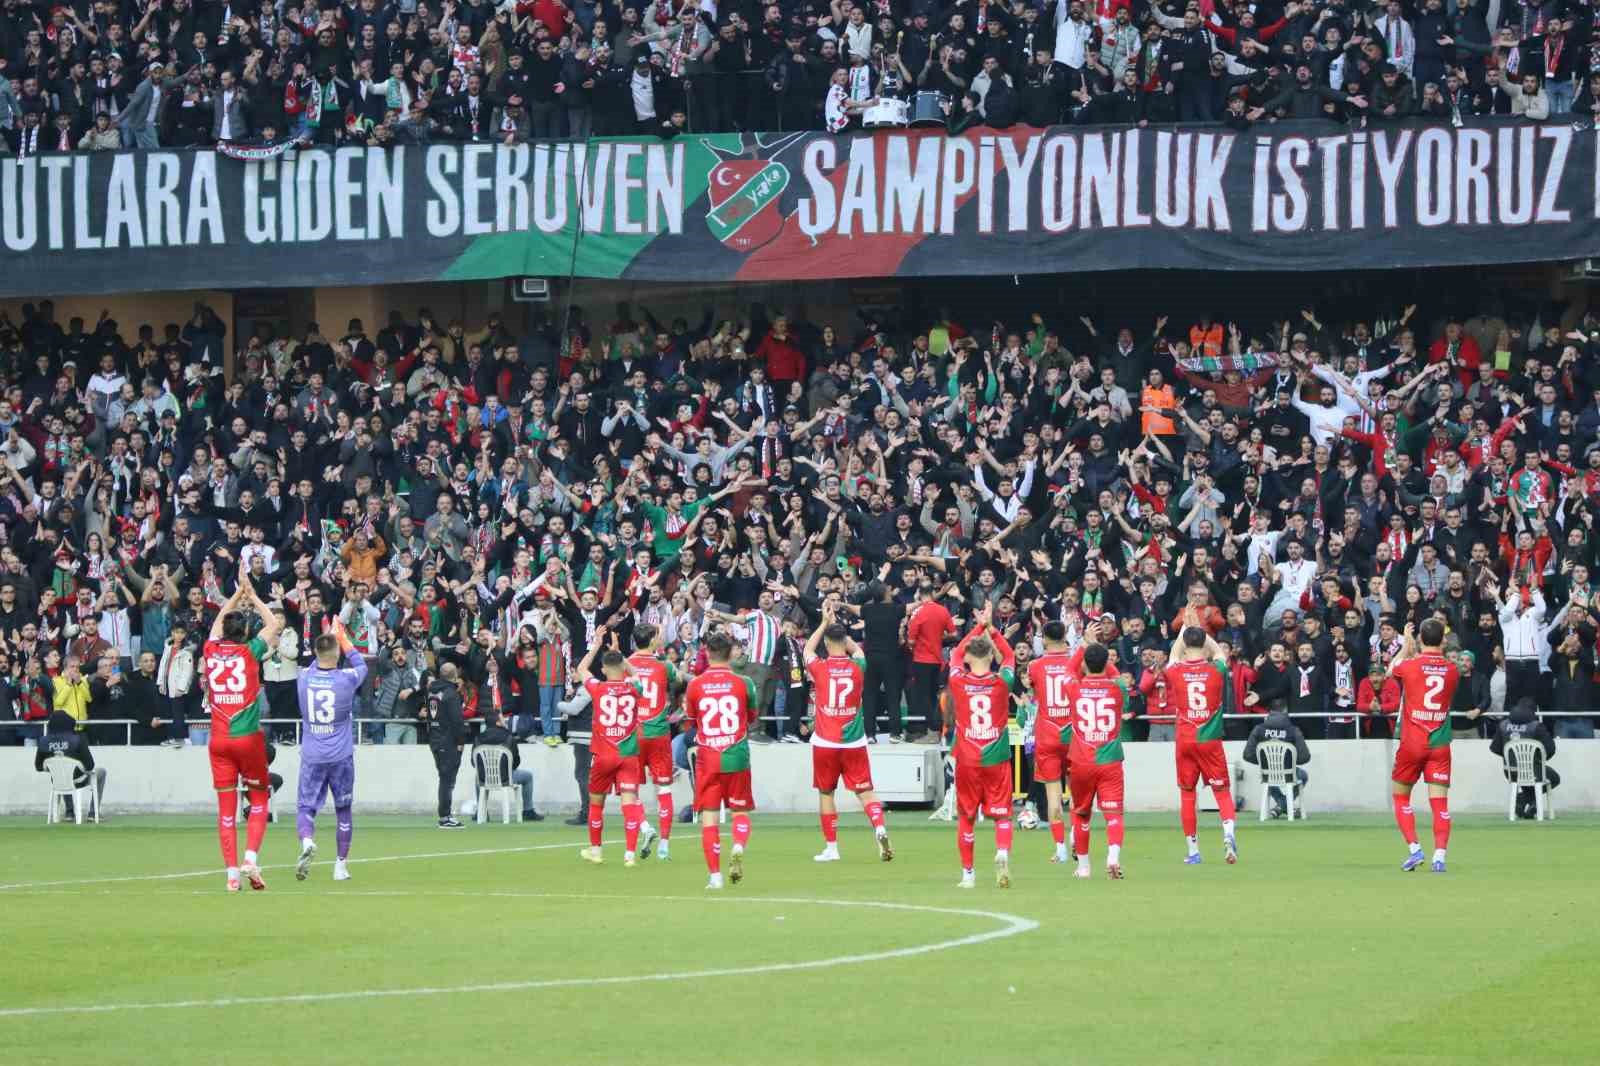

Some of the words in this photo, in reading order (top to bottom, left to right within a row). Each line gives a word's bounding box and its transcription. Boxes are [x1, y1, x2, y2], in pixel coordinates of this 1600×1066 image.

[2, 150, 226, 252] UTLARA
[798, 128, 1235, 246] ŞAMPİYONLUK
[1251, 126, 1574, 233] İSTİYORUZ
[208, 656, 247, 692] 23
[1045, 675, 1070, 707] 10
[307, 688, 336, 724] 13
[642, 677, 658, 708] 4
[828, 677, 854, 708] 17
[1187, 681, 1208, 710] 6
[1423, 675, 1445, 710] 2
[600, 695, 636, 727] 93
[699, 695, 740, 736] 28
[969, 694, 992, 729] 8
[1075, 697, 1116, 732] 95
